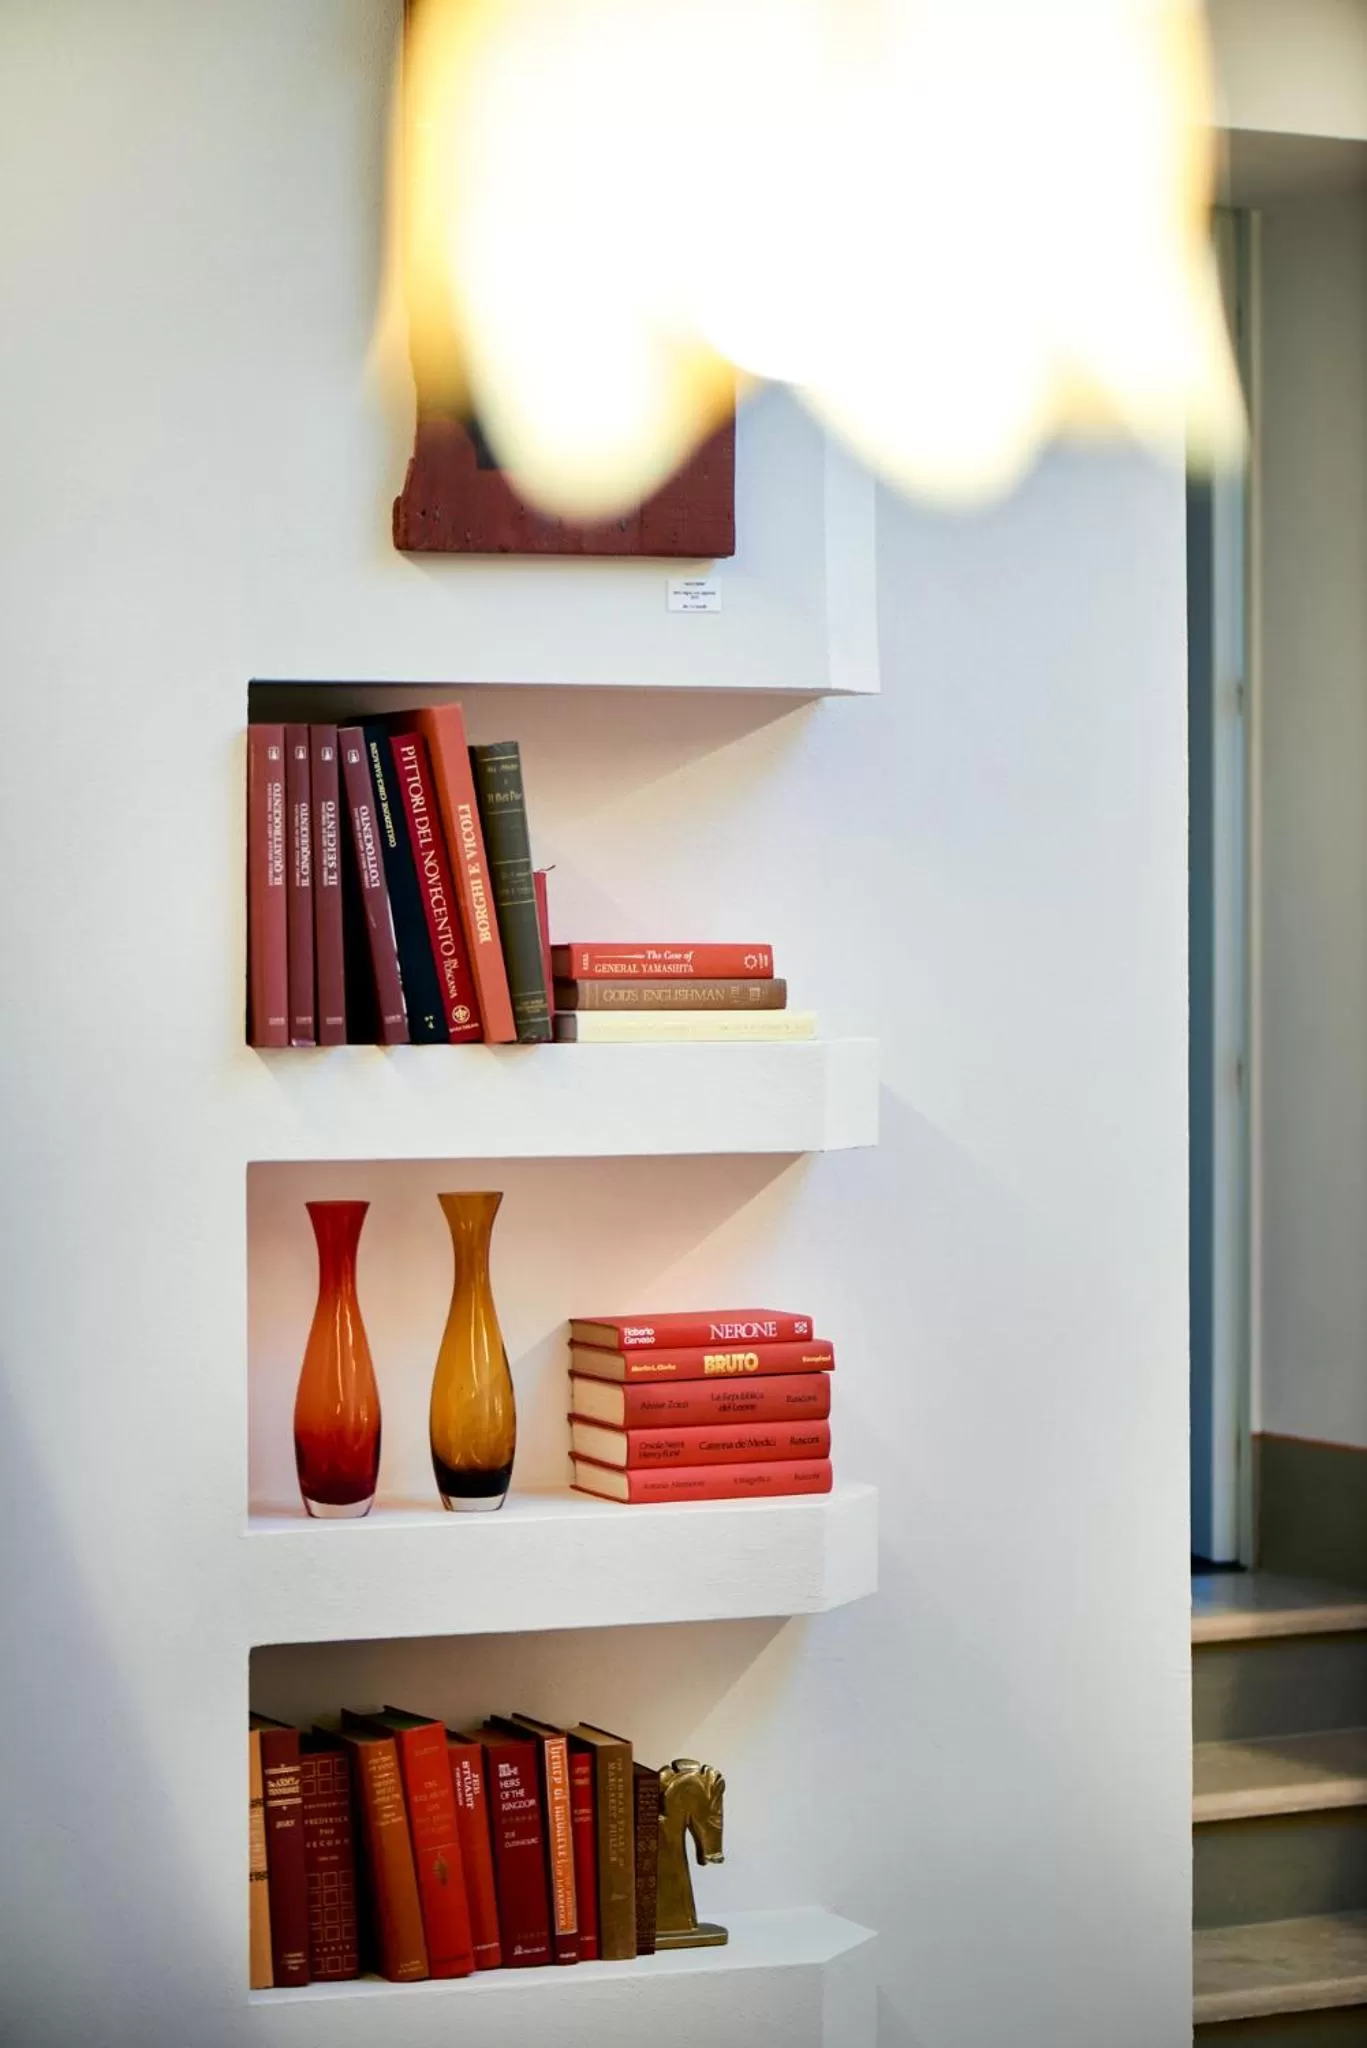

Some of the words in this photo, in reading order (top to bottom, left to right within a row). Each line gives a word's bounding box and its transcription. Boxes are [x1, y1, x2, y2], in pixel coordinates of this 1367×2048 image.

[400, 745, 428, 813] PITTORI
[273, 782, 284, 873] QUATTROCENTO
[300, 803, 311, 875] CINQUECENTO
[326, 800, 337, 868] SEICENTO
[359, 805, 380, 888] L'OTTOCENTO
[380, 801, 397, 848] COLLEZIONE
[414, 817, 434, 848] DEL
[458, 804, 478, 859] VICOLI
[326, 872, 338, 886] IL
[467, 864, 482, 877] E
[422, 851, 456, 956] NOVECENTO
[471, 881, 493, 943] BORGHI
[594, 963, 639, 973] GENERAL
[641, 963, 694, 973] YAMASHITA
[646, 950, 661, 960] The
[684, 950, 694, 962] of
[643, 987, 726, 1002] ENGLISHMAN
[710, 1321, 777, 1340] NERONE
[704, 1352, 759, 1374] BRUTO
[462, 1761, 474, 1809] STUART
[502, 1800, 537, 1812] KINGDOM
